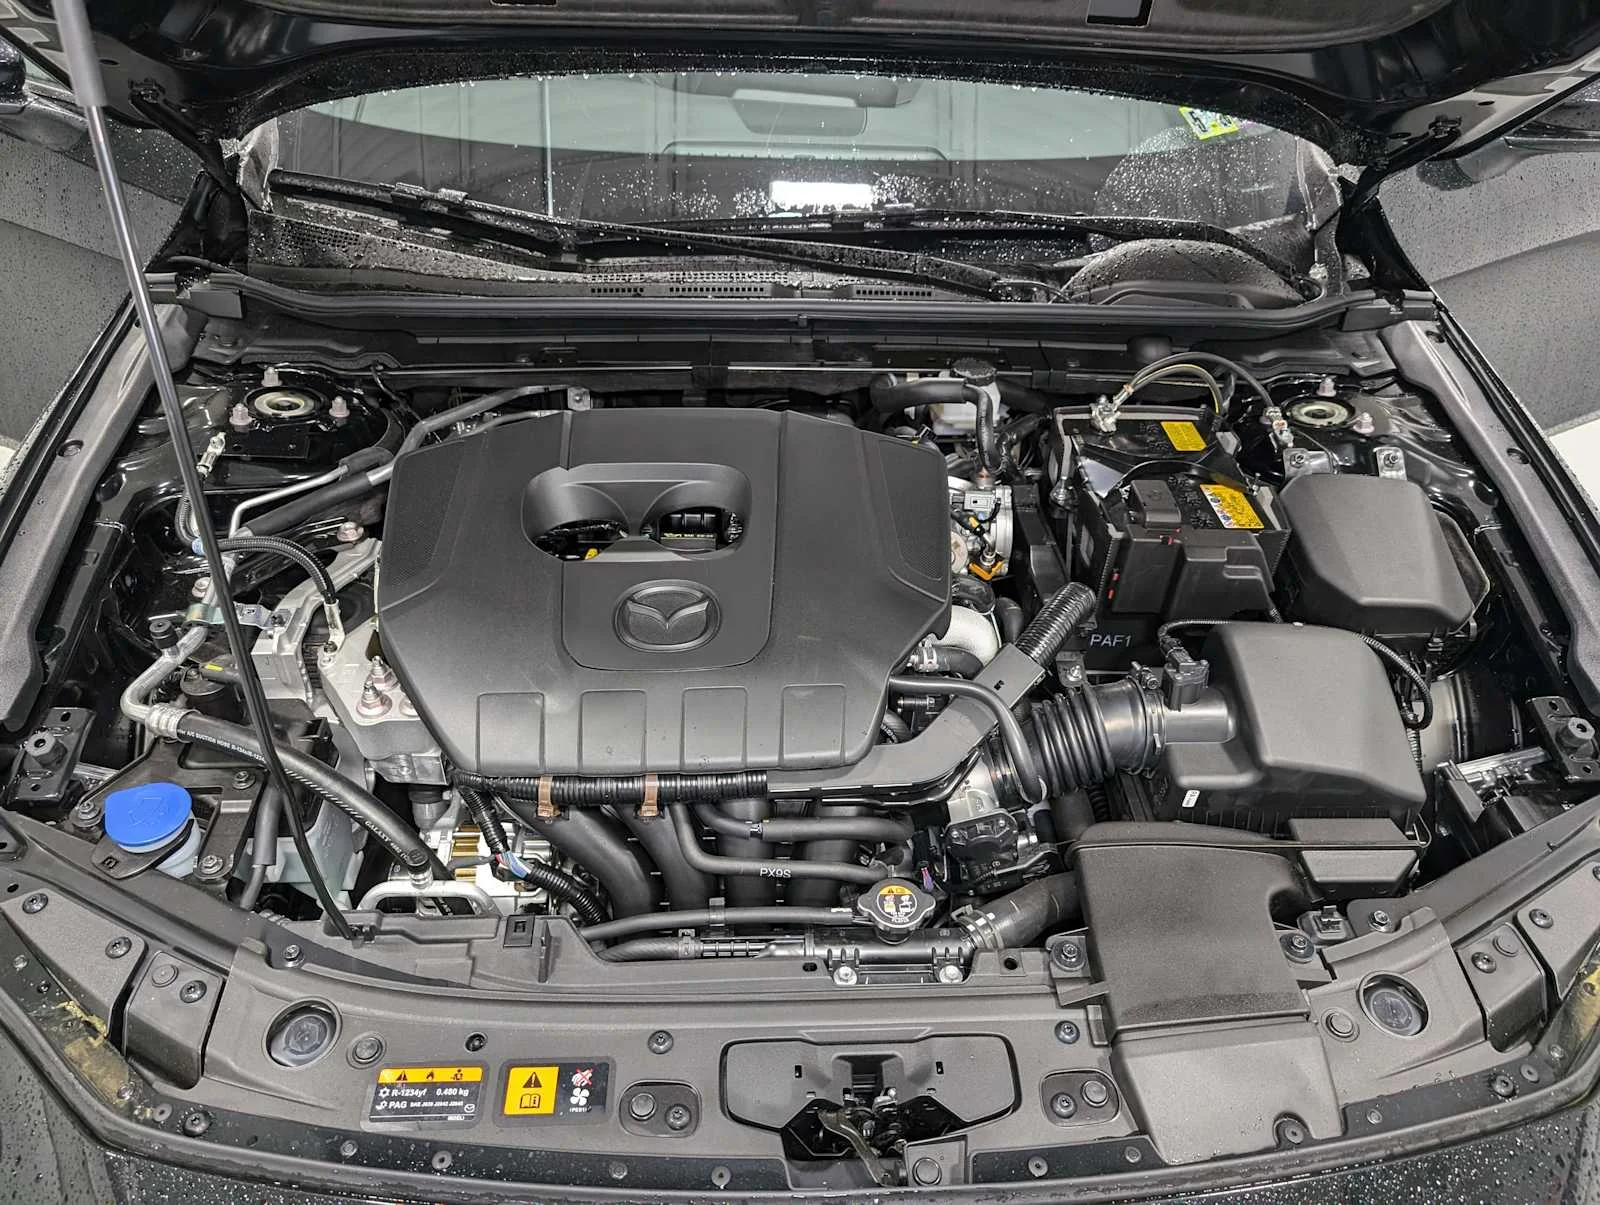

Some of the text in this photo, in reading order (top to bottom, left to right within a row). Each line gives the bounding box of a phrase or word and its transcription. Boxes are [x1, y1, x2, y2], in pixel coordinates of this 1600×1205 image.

[1090, 633, 1131, 647] PAF1
[196, 732, 216, 744] SUCTION
[365, 820, 391, 842] GALAXY
[759, 867, 792, 879] PX9S
[391, 1087, 428, 1098] R-1234yf
[458, 1087, 470, 1097] kg
[388, 1100, 408, 1109] PAG
